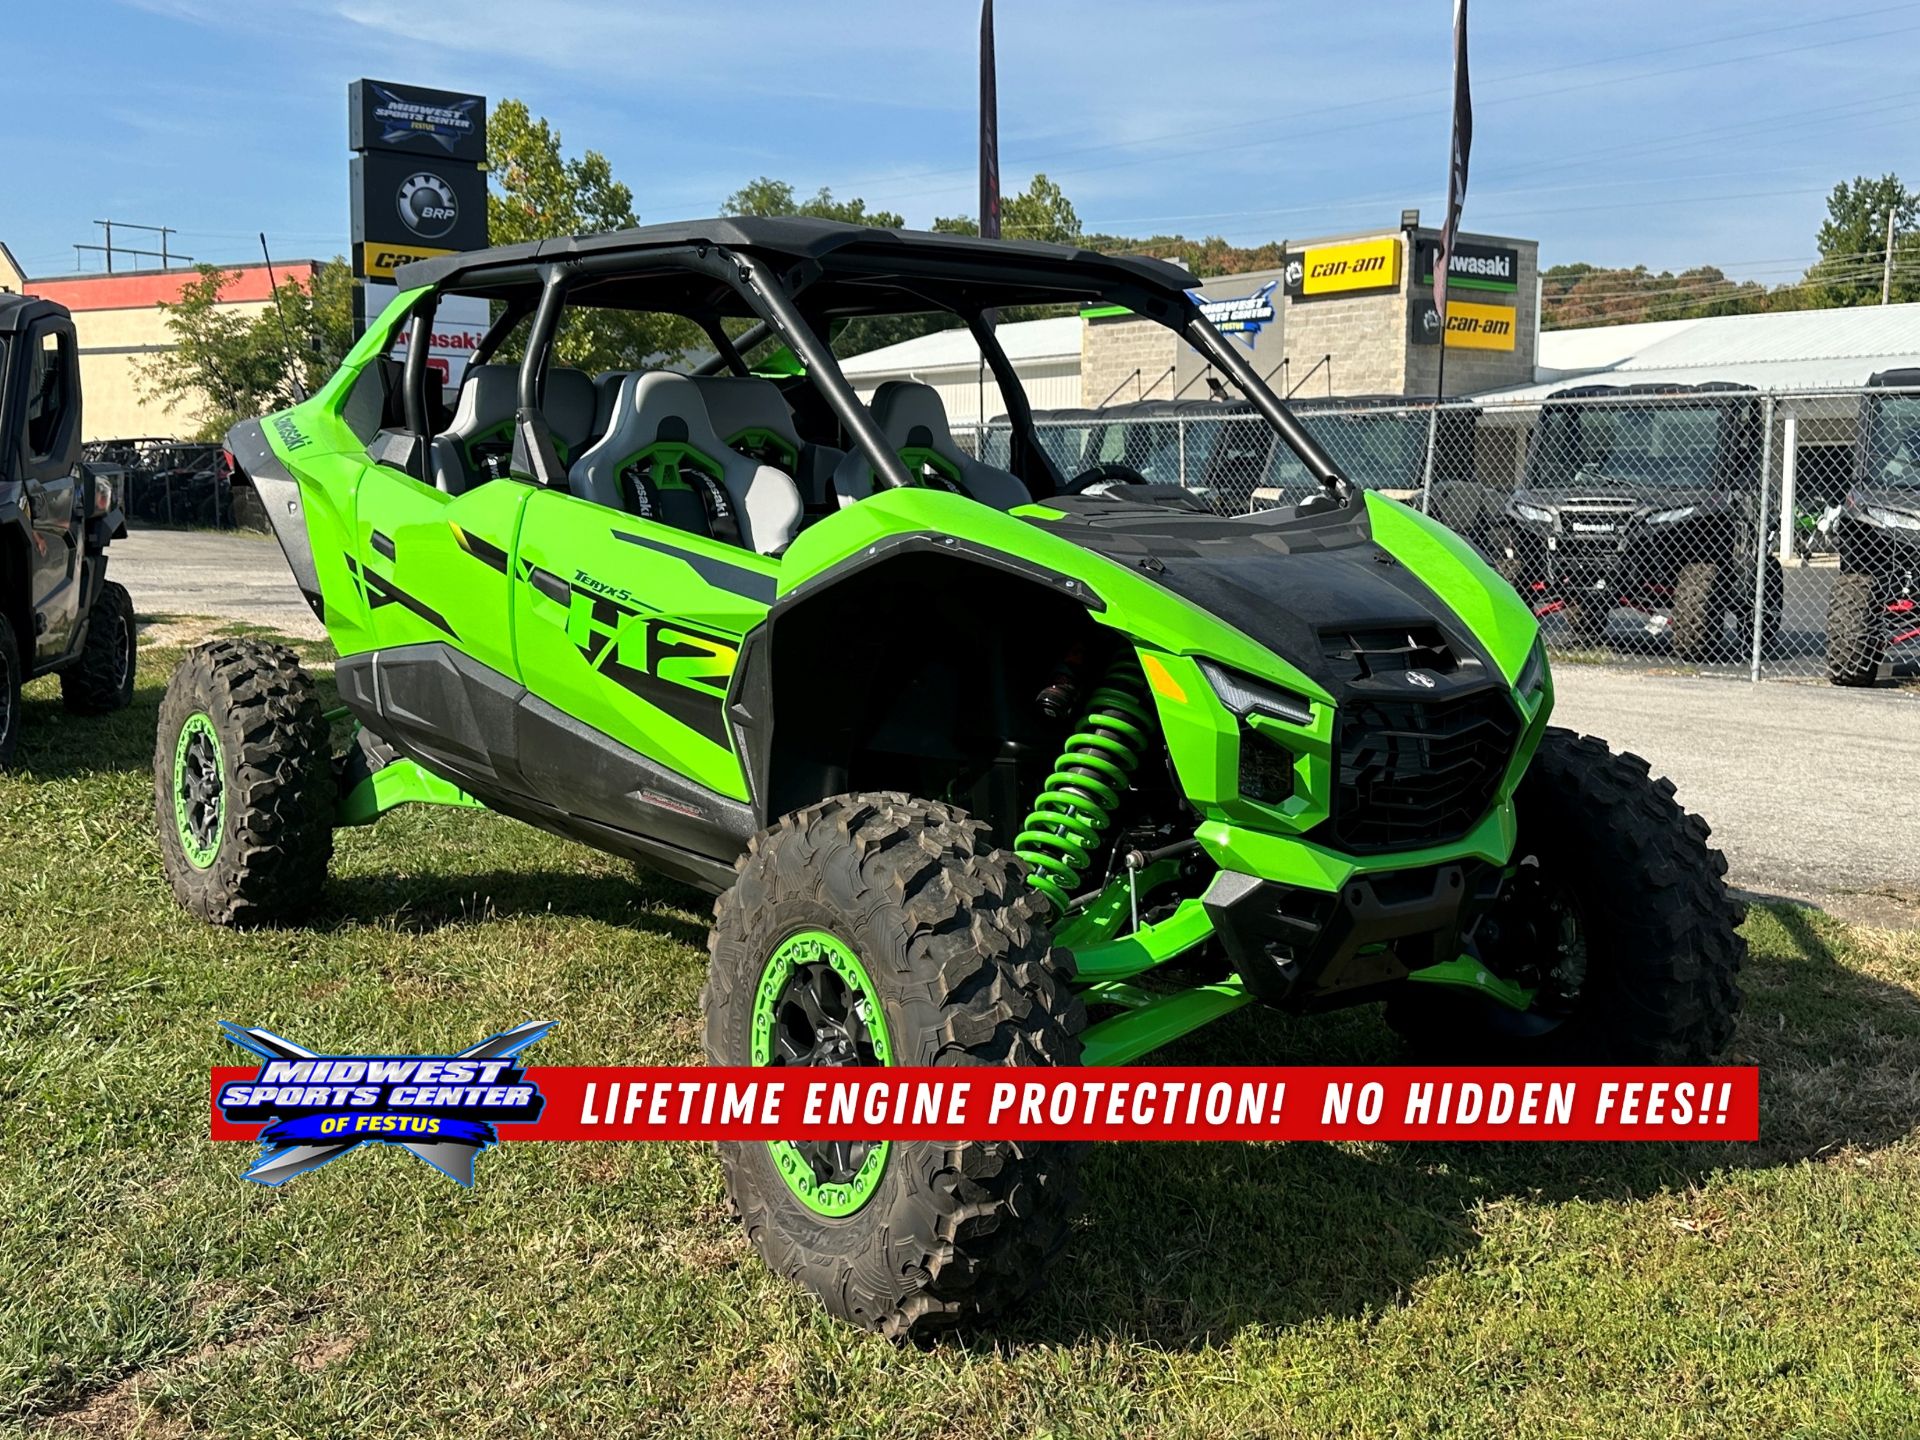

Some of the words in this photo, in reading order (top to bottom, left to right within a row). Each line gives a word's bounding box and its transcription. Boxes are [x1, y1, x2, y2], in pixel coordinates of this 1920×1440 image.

[375, 108, 425, 121] SPORTS
[426, 115, 470, 128] CENTER
[388, 102, 462, 118] MIDWEST
[422, 207, 455, 220] BRP
[1311, 256, 1385, 278] can-am
[1446, 316, 1510, 335] can-am
[272, 411, 312, 452] Kawasaki
